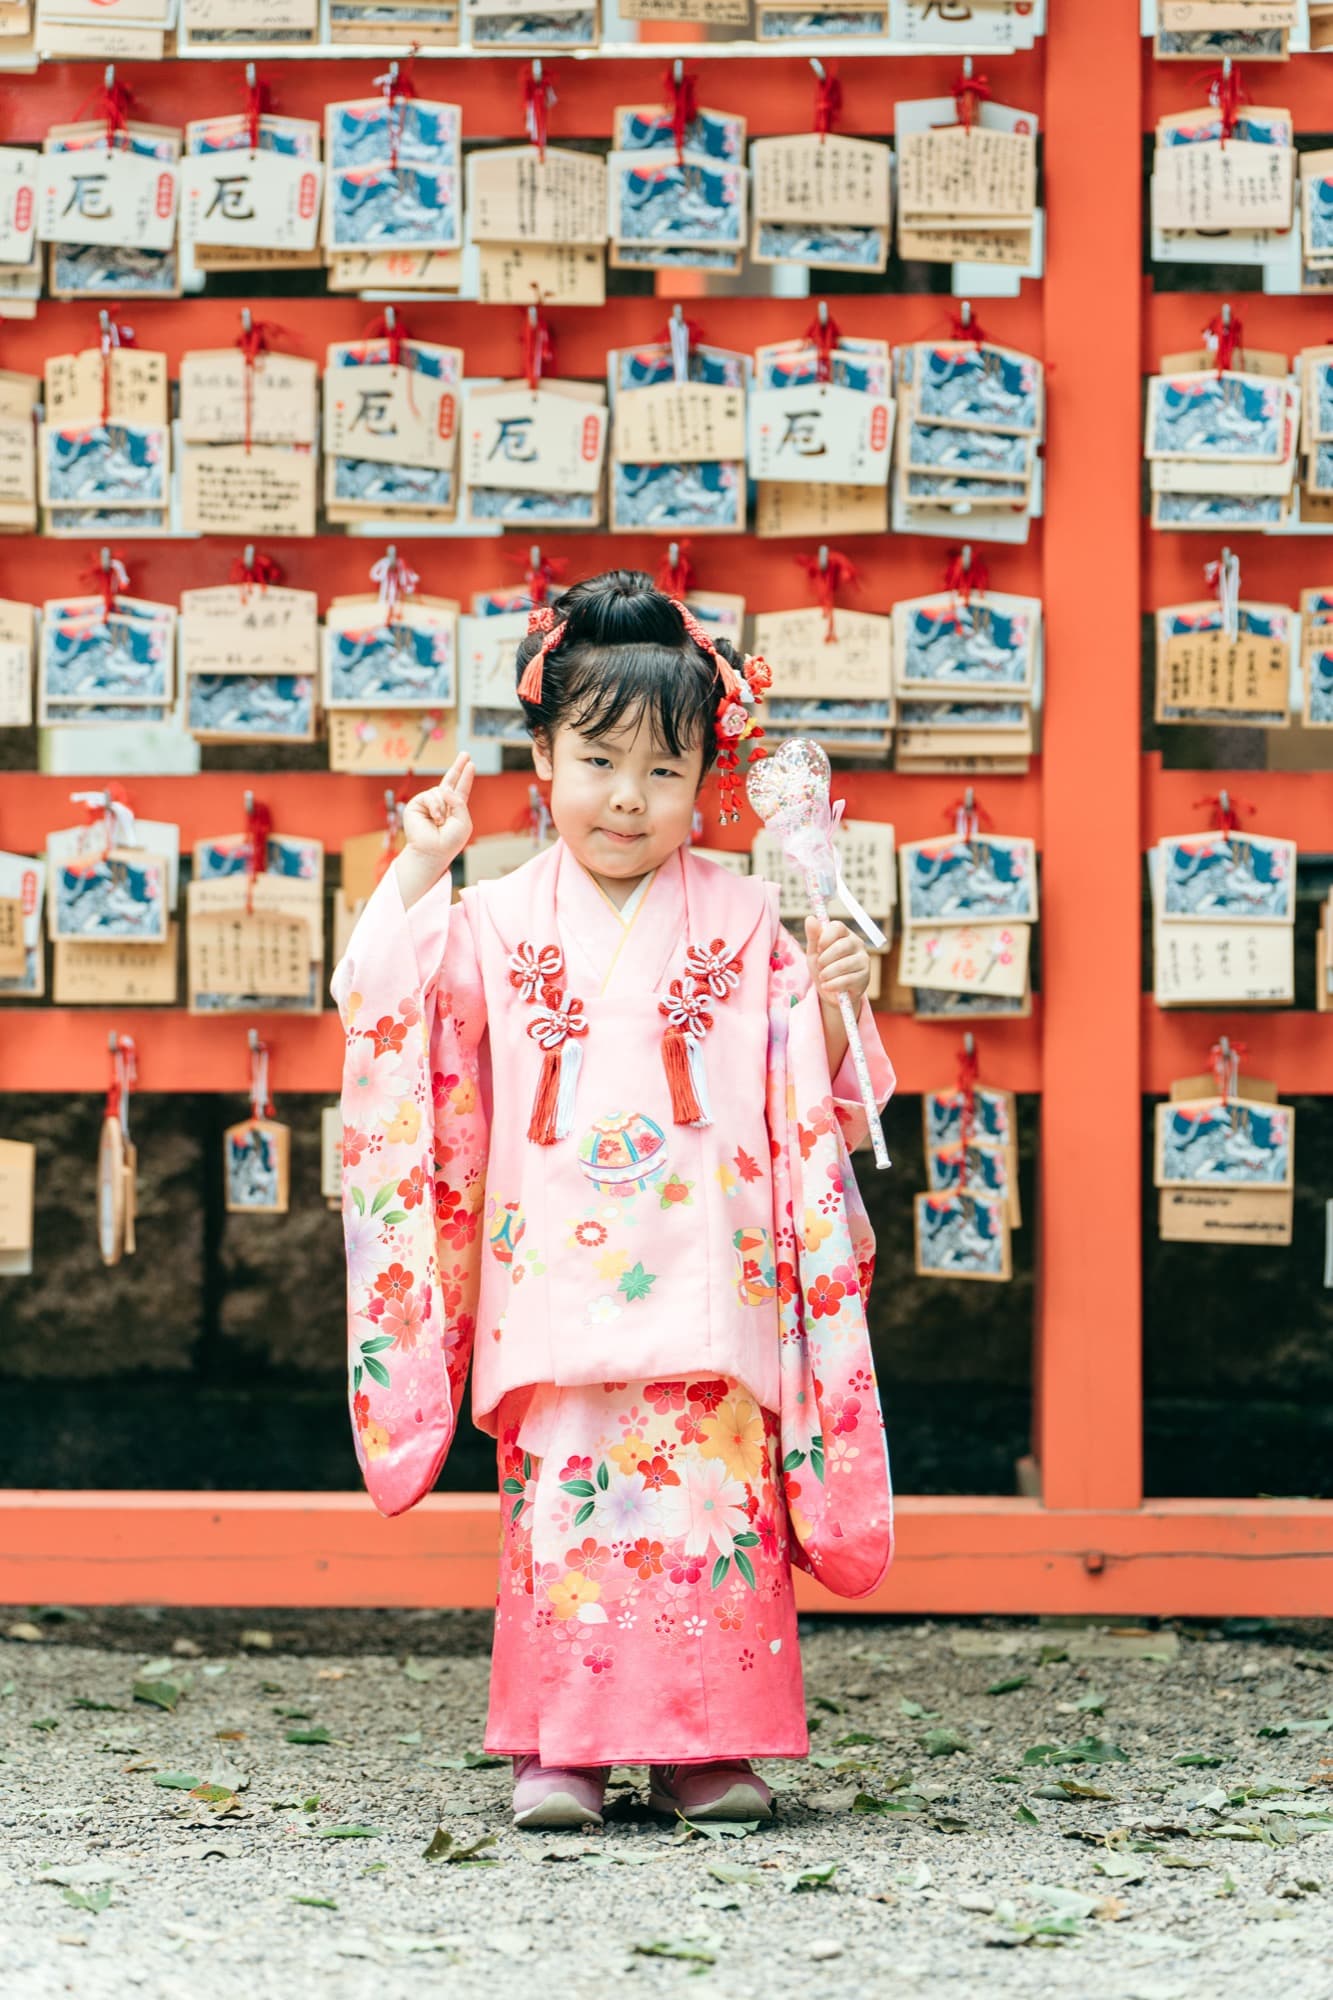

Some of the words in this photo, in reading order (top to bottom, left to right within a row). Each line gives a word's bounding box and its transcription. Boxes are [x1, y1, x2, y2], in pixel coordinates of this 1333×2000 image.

[61, 173, 113, 219] 厄
[205, 175, 255, 219] 厄
[349, 390, 398, 436] 厄
[777, 409, 827, 457] 厄
[487, 417, 539, 463] 厄
